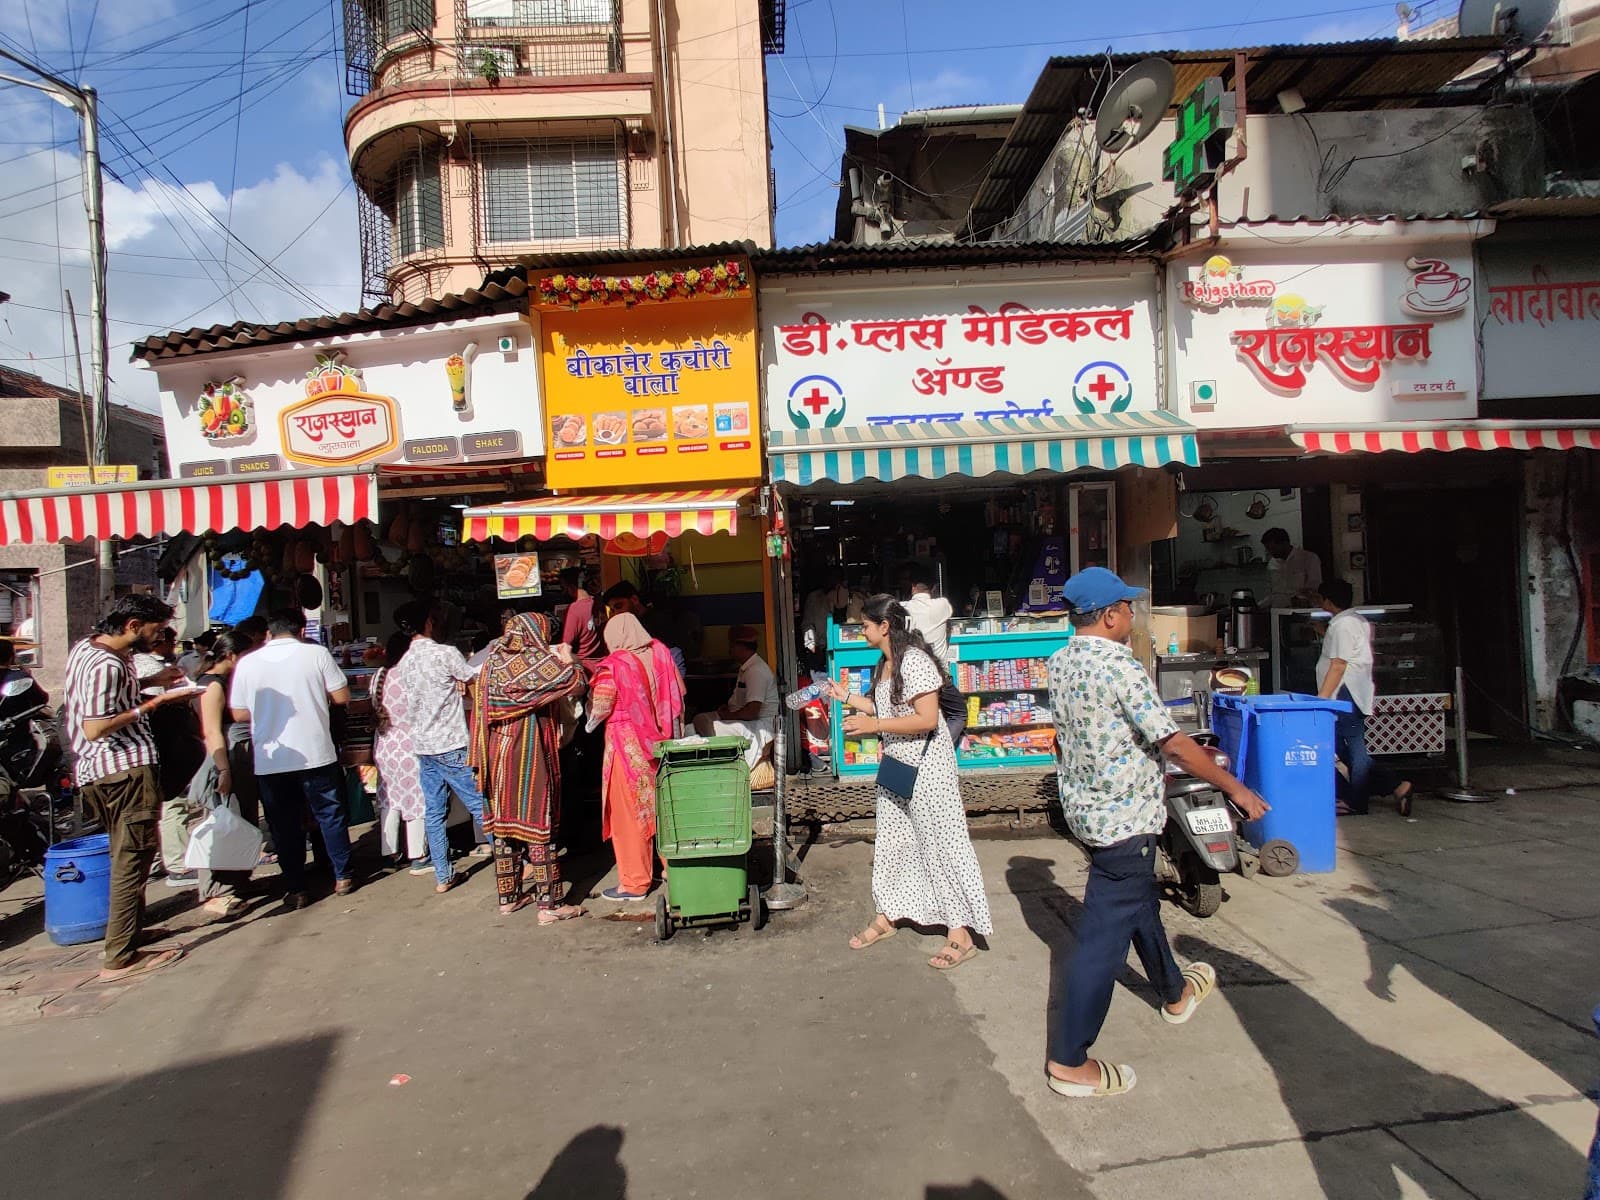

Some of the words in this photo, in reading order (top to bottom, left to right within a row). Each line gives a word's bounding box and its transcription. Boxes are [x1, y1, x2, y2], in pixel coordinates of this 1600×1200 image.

[1183, 280, 1276, 304] Rajasthan
[962, 301, 1134, 346] मेडिकल
[566, 346, 651, 377] बीकानेर
[660, 340, 731, 370] कचोरी
[1234, 323, 1434, 389] राजस्थान
[624, 371, 680, 396] वाला
[294, 407, 376, 442] राजस्थान
[412, 444, 449, 455] FALOODA
[475, 437, 504, 448] SHAKE
[193, 466, 214, 476] JUICE
[240, 461, 270, 472] SNACKS
